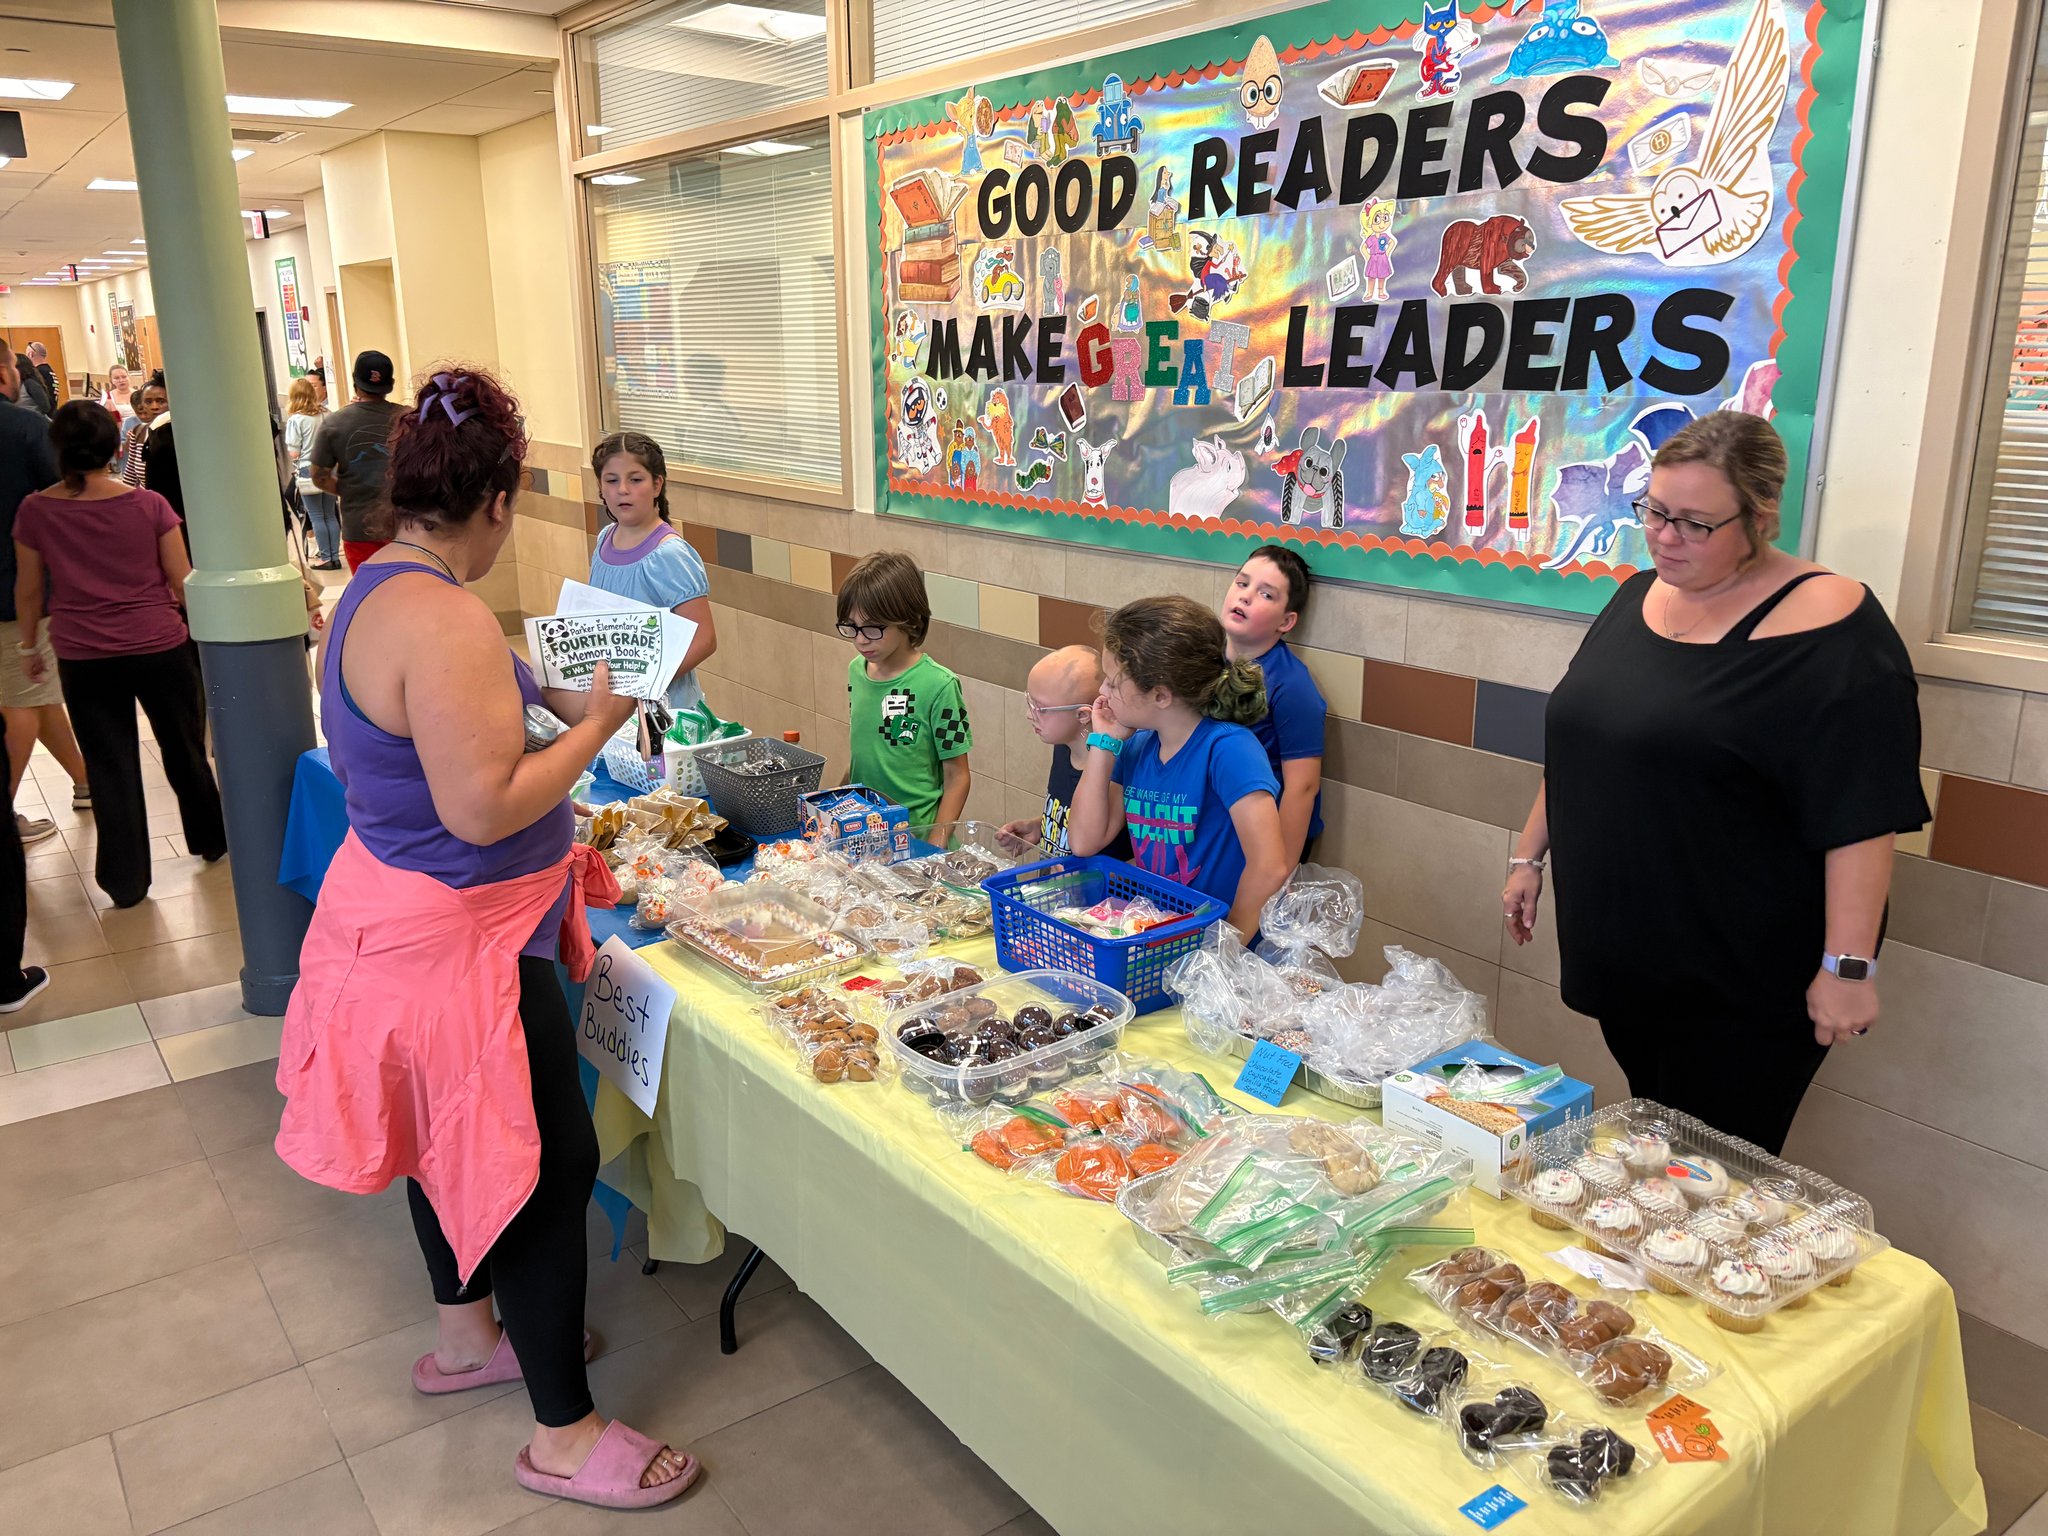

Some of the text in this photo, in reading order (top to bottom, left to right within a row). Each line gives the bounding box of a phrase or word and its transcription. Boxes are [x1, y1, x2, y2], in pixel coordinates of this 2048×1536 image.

[977, 76, 1611, 240] GOOD READERS
[925, 288, 1736, 406] MAKE GREAT LEADERS
[570, 622, 638, 636] Parker Elementary
[549, 632, 656, 657] FOURTH GRADE
[568, 646, 641, 665] Memory Book
[572, 664, 584, 675] We
[623, 660, 641, 672] Help!
[1161, 792, 1171, 803] OF
[1173, 793, 1187, 804] MY
[869, 822, 888, 830] MINI
[895, 834, 908, 846] 12
[594, 954, 650, 1033] Best
[584, 1002, 649, 1087] Buddies
[1256, 1047, 1294, 1069] Nut Free
